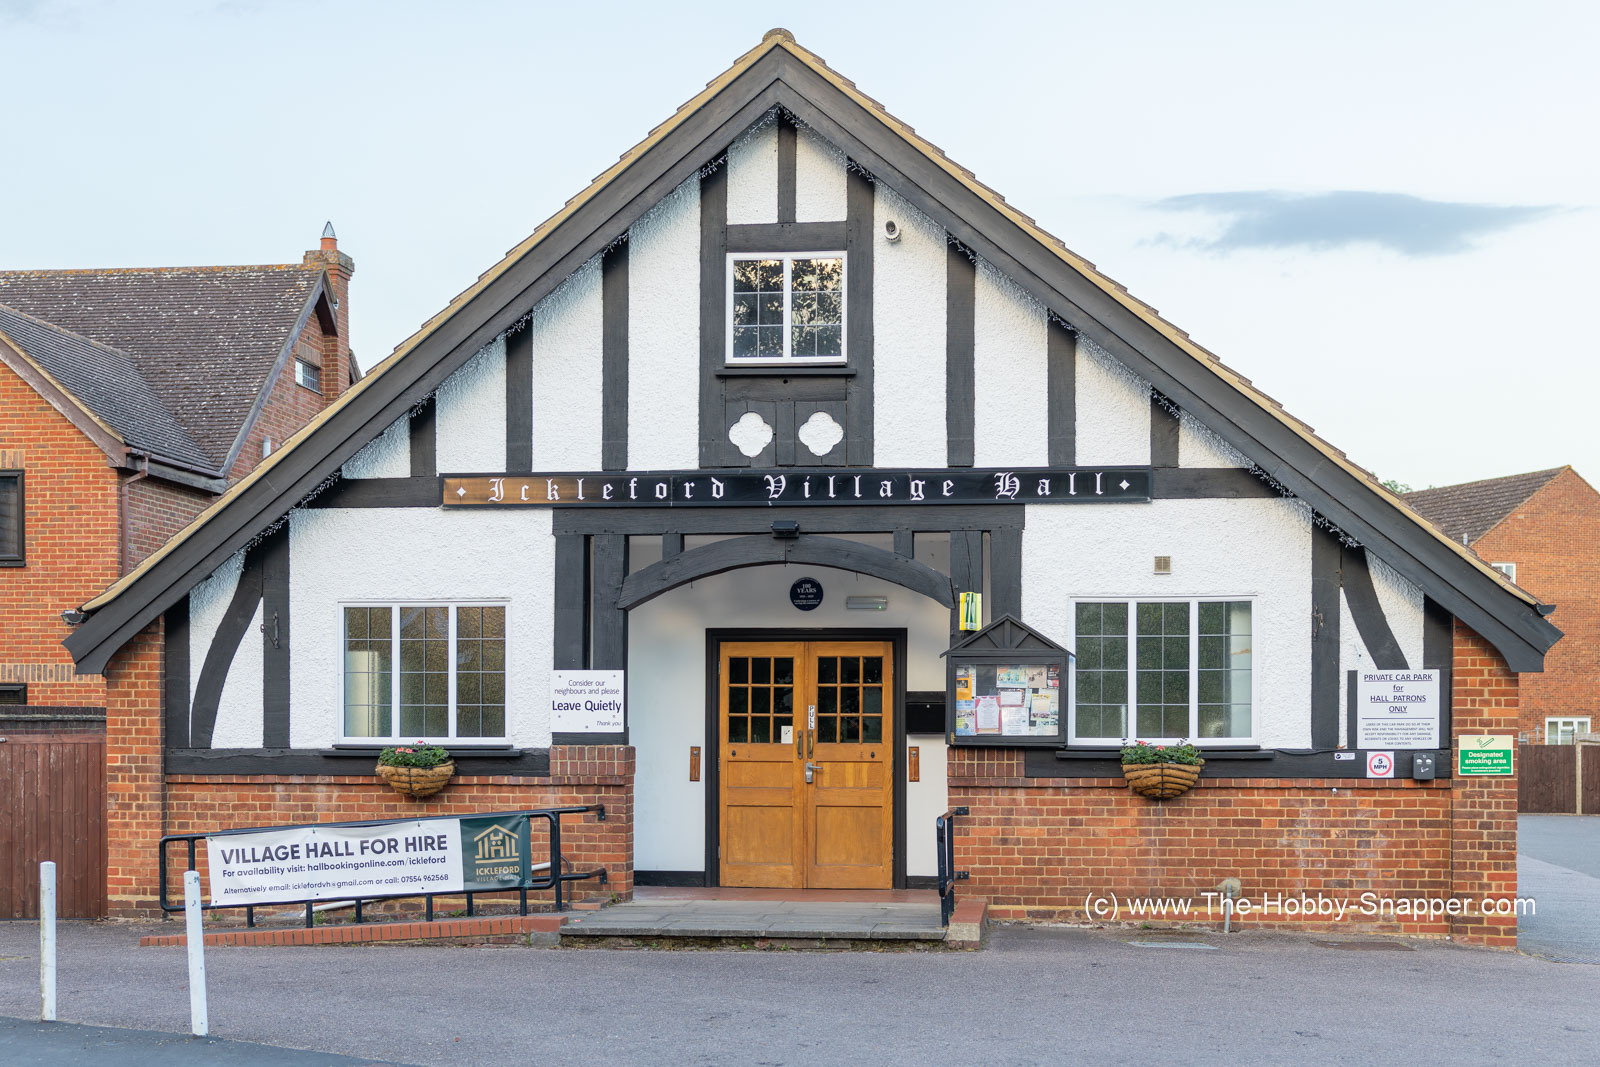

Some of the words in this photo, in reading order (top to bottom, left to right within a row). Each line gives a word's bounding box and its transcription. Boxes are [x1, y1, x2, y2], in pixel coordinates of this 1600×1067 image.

[488, 477, 724, 502] Ickleford
[764, 474, 954, 500] Village
[994, 472, 1104, 500] Hall
[554, 688, 586, 696] neighbours
[601, 688, 620, 696] please
[552, 700, 581, 710] Leave
[585, 700, 622, 713] Quietly
[220, 844, 300, 864] VILLAGE
[305, 841, 354, 858] HALL
[360, 838, 399, 855] FOR
[405, 835, 447, 852] HIRE
[237, 866, 285, 877] availability
[287, 865, 306, 873] visit:
[307, 856, 446, 871] hallbookingonline.com/ickleford
[476, 866, 520, 875] ICKLEFORD
[224, 885, 267, 894] Alternatively
